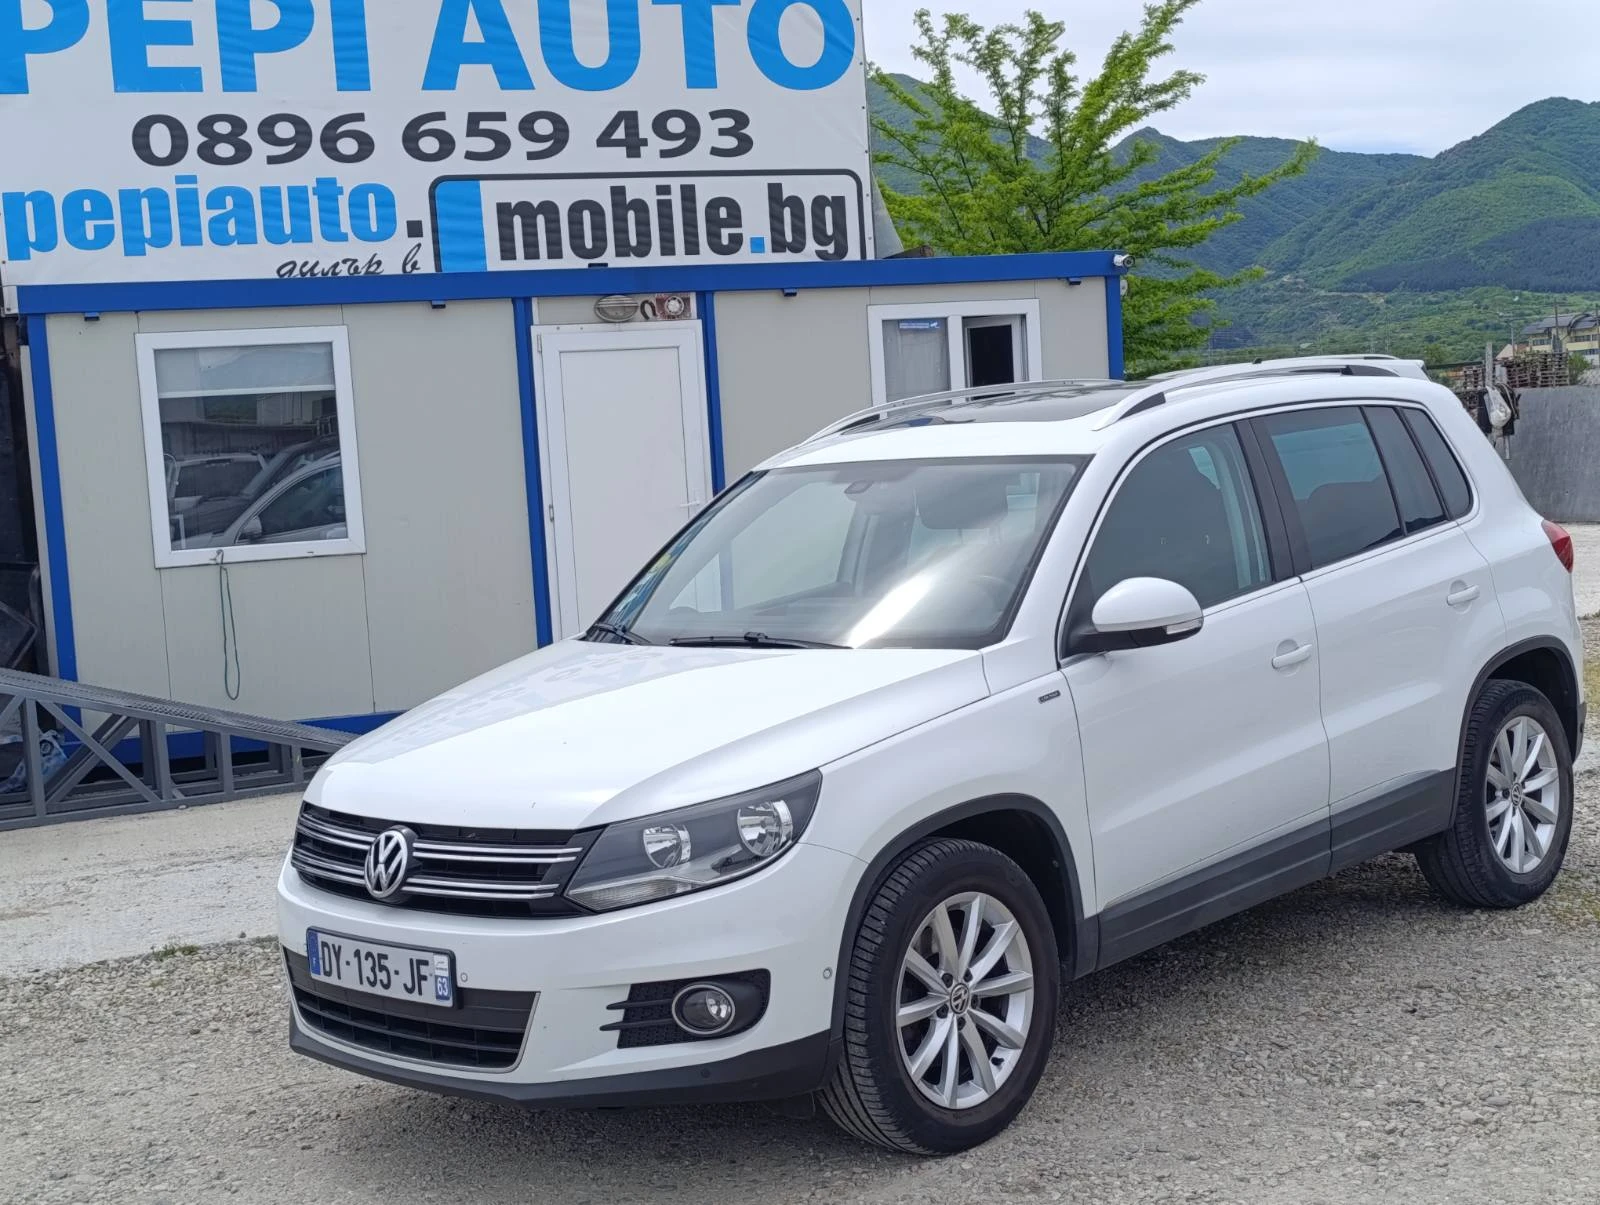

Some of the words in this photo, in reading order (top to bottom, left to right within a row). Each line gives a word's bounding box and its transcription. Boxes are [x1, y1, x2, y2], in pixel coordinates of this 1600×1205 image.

[0, 0, 371, 94] PEPI
[421, 0, 855, 92] AUTO
[131, 112, 376, 166] 0896
[402, 110, 570, 162] 659
[596, 108, 754, 159] 493
[496, 182, 848, 261] mobile.bg
[437, 976, 449, 996] 63
